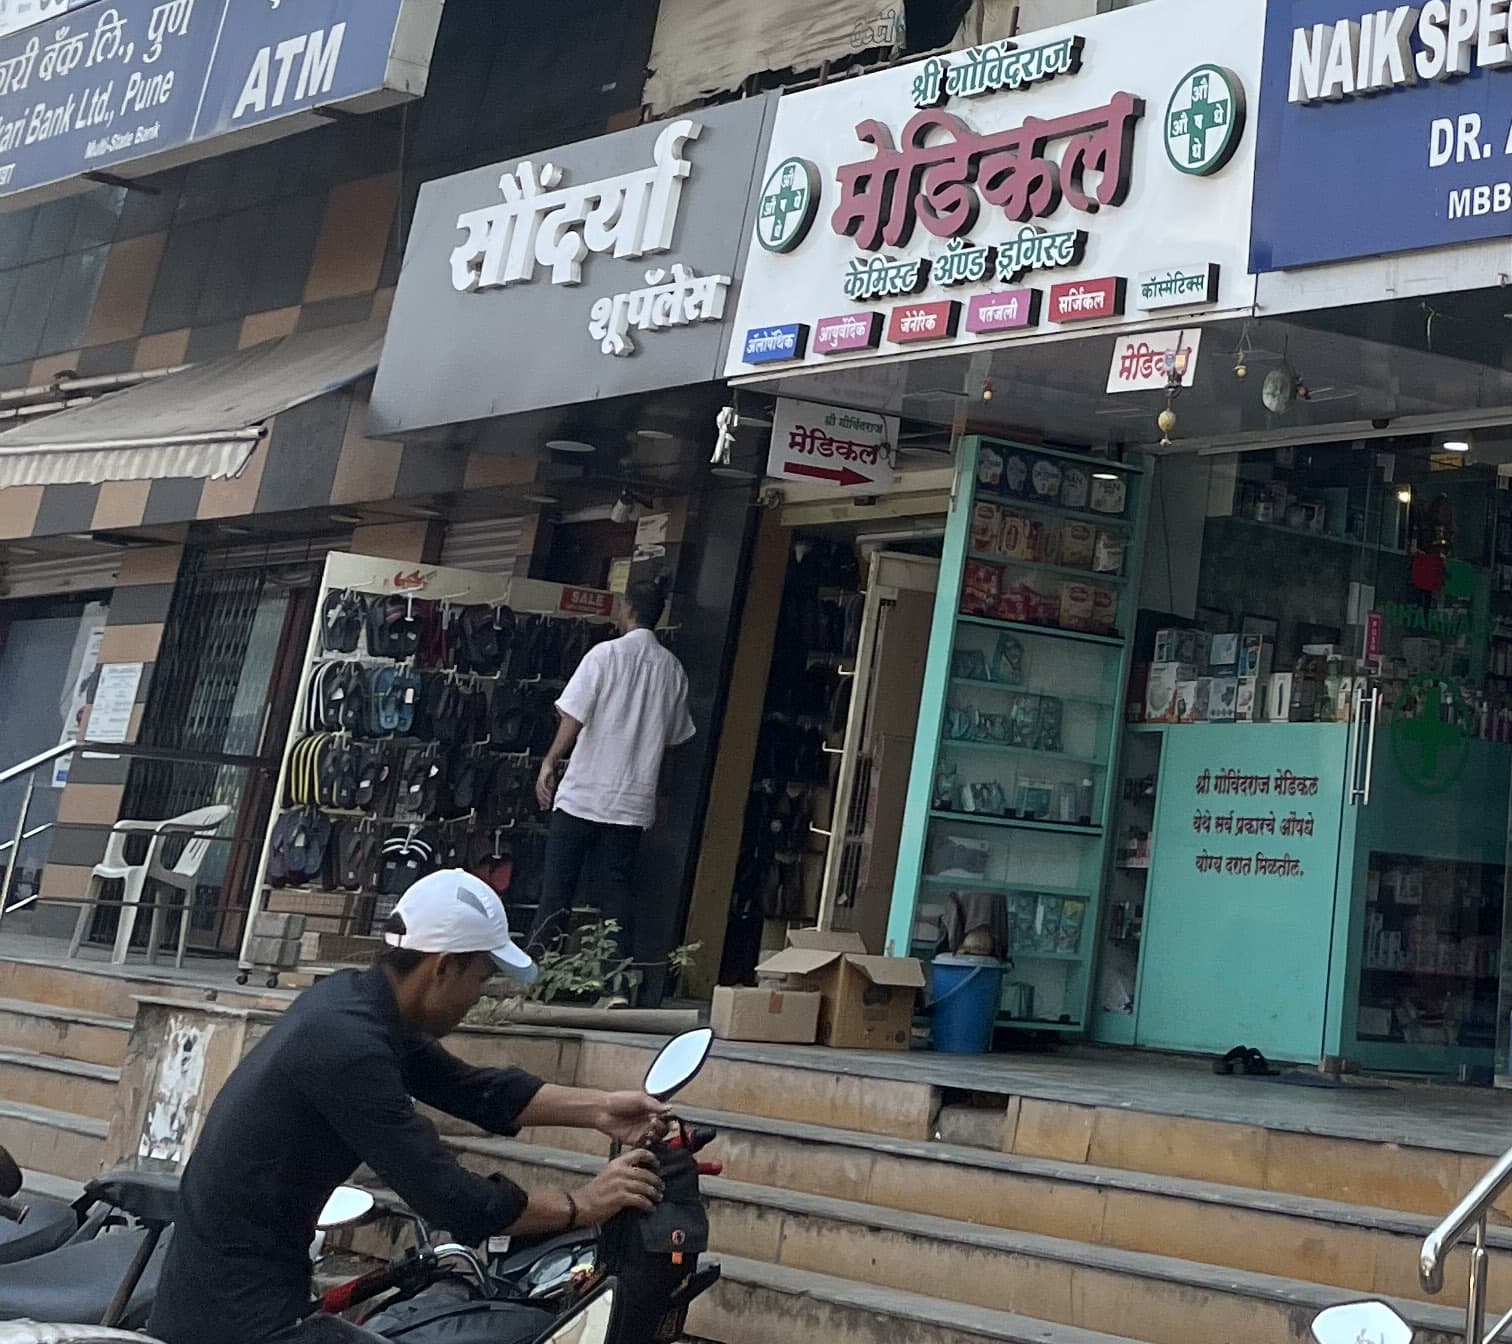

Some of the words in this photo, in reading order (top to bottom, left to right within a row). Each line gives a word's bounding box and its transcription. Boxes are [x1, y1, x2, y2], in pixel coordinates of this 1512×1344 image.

[39, 23, 89, 82] बँक
[232, 22, 346, 120] ATM
[911, 60, 947, 109] श्री
[946, 35, 1084, 98] गोविंदराज
[1288, 2, 1420, 105] NAIK
[25, 96, 71, 147] Bank
[121, 69, 176, 119] Pune
[134, 121, 161, 145] Bank
[1428, 113, 1491, 169] DR.
[831, 90, 1144, 250] मेडिकल
[450, 119, 703, 292] सौंदर्या
[843, 255, 922, 301] केमिस्ट
[978, 297, 1018, 323] पतंजली
[1058, 286, 1106, 314] सर्जिकल
[789, 425, 880, 465] मेडिकल
[570, 591, 606, 607] SALE
[1196, 768, 1210, 795] श्री
[1214, 768, 1271, 795] गोविंदराज
[1274, 769, 1319, 796] मेडिकल
